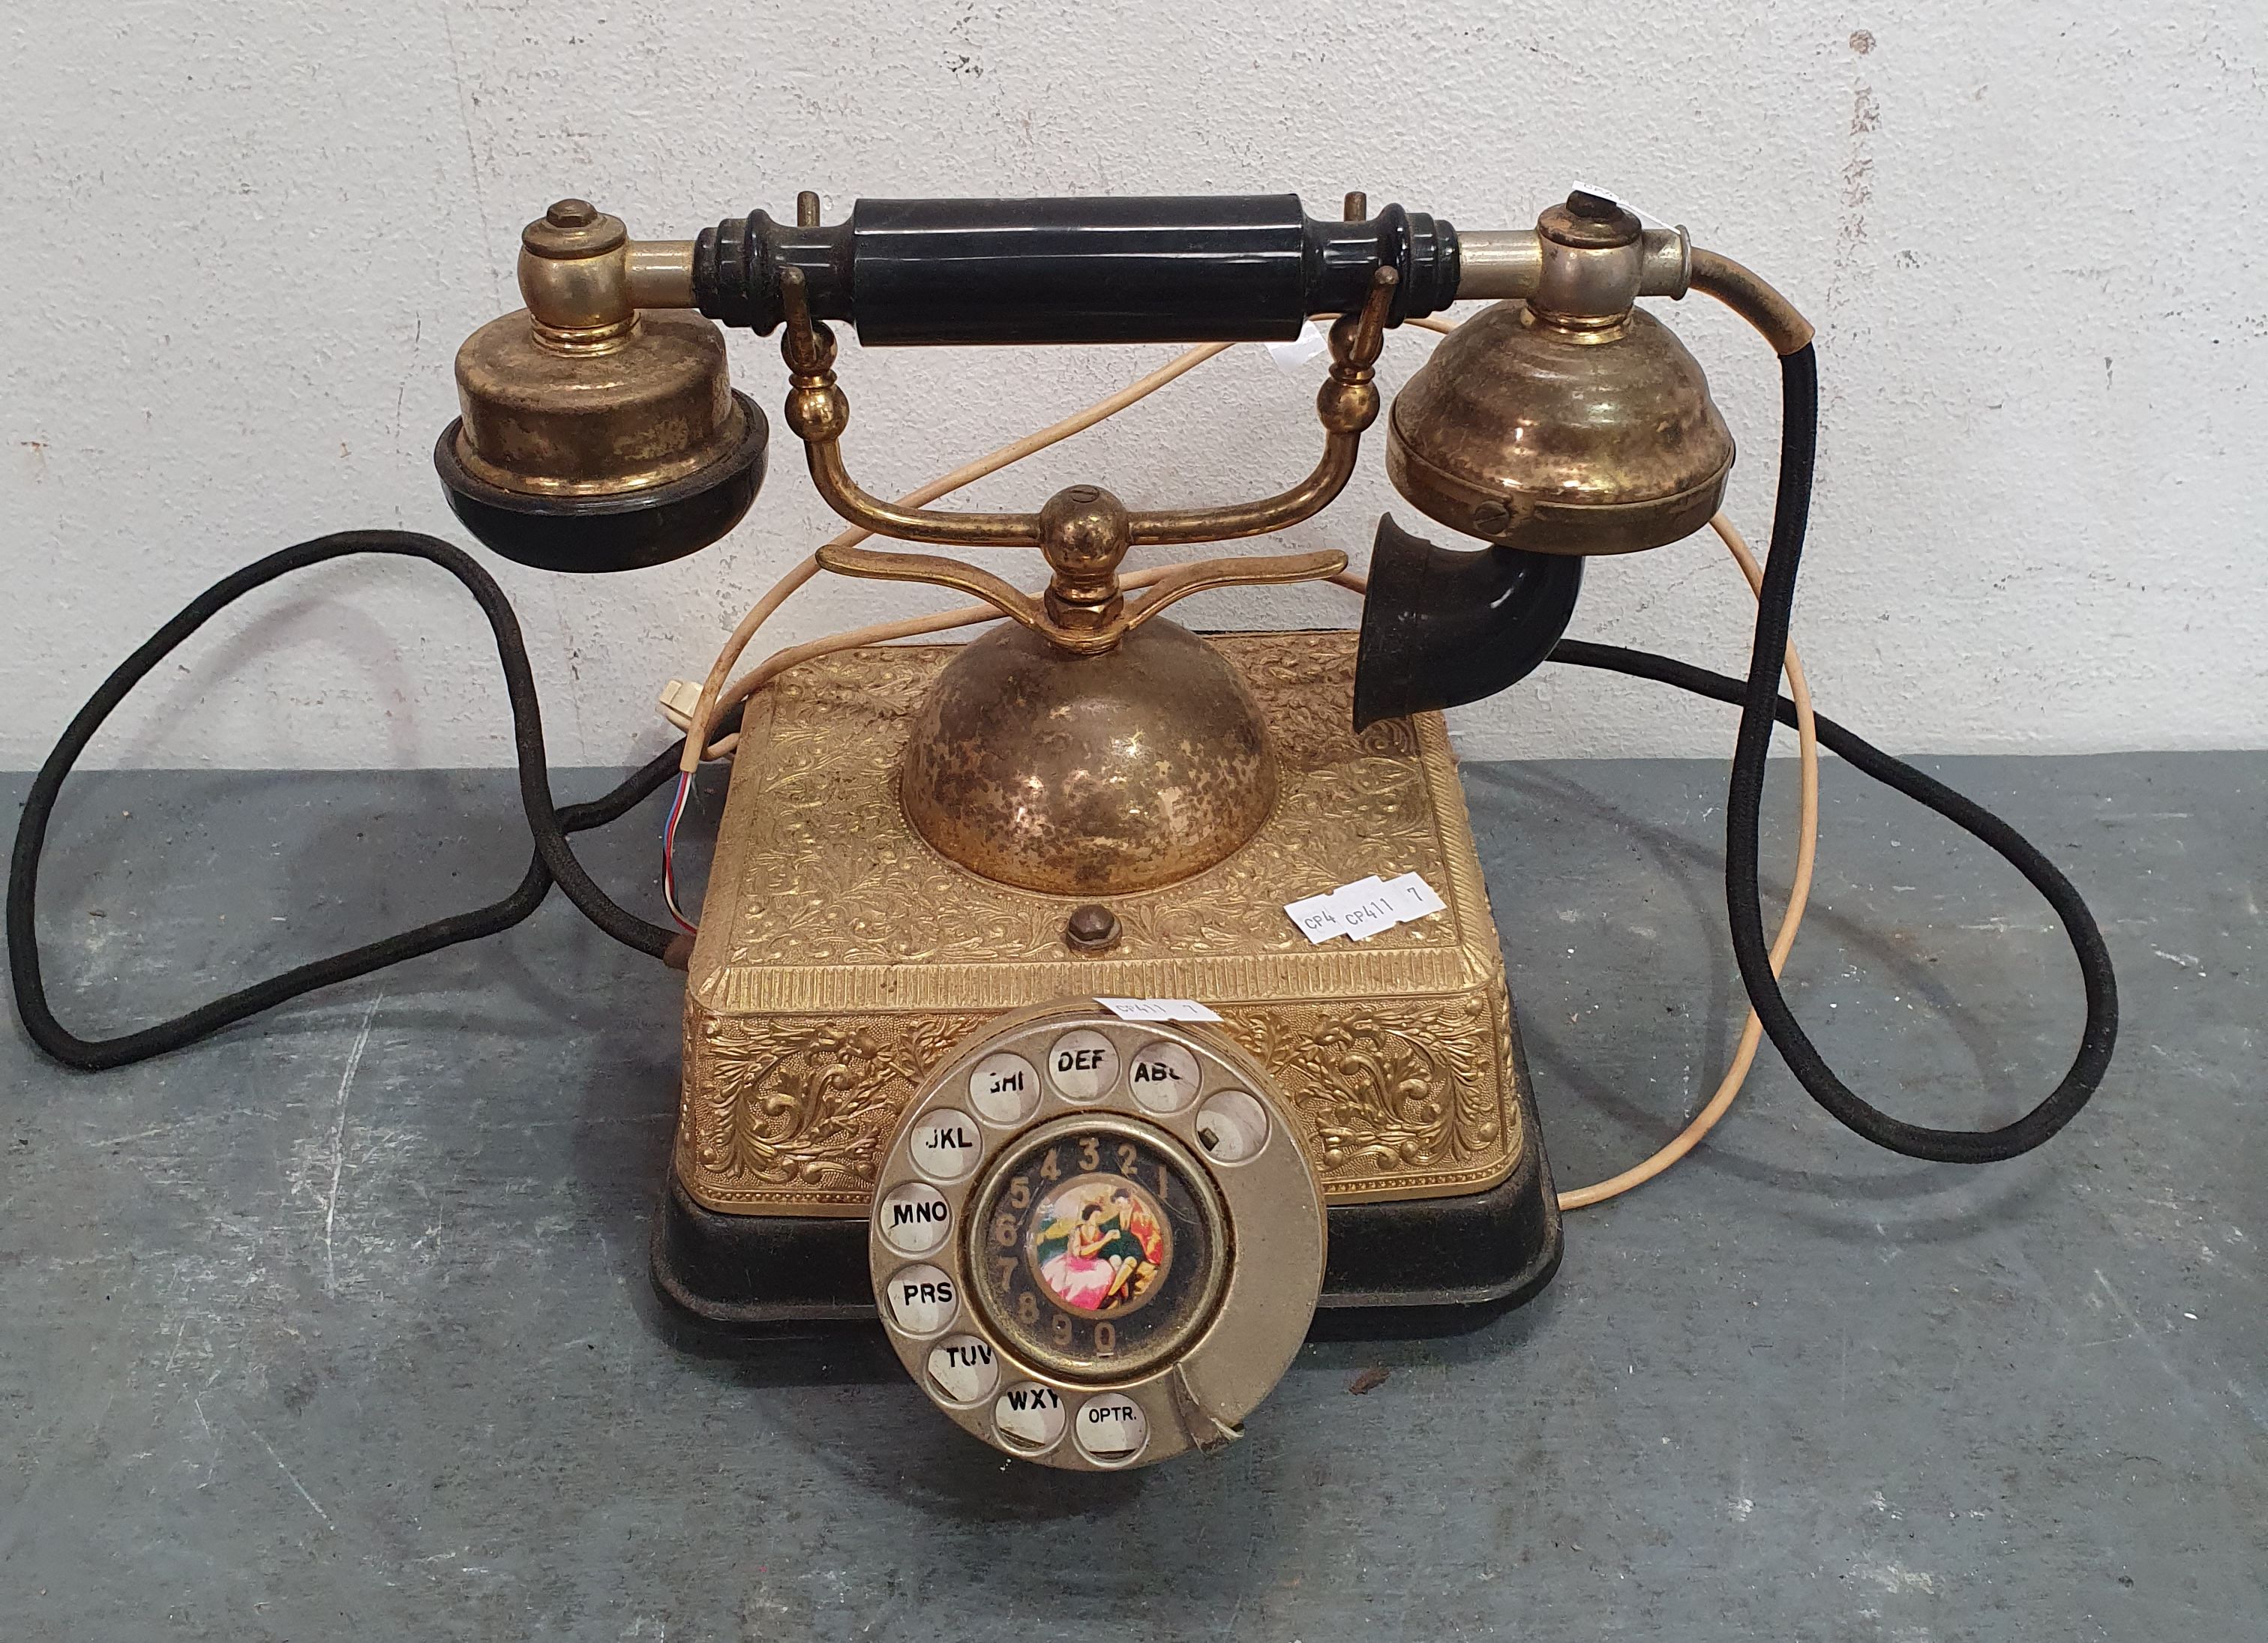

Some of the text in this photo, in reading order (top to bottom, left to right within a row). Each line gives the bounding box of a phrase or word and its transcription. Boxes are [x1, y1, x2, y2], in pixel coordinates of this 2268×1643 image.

[1346, 898, 1394, 925] CP411
[1407, 887, 1423, 902] 7
[1116, 1003, 1166, 1014] CP411
[1058, 1049, 1106, 1072] DEF
[926, 1128, 974, 1150] JKL
[1040, 1147, 1063, 1181] 4
[1078, 1137, 1100, 1171] 3
[1118, 1143, 1138, 1177] 2
[1011, 1176, 1030, 1210] 5
[889, 1201, 948, 1230] MNO
[995, 1213, 1018, 1247] 6
[904, 1282, 953, 1306] PRS
[946, 1344, 992, 1368] TUV
[1007, 1388, 1058, 1411] WXY
[1088, 1405, 1138, 1424] OPTR.
